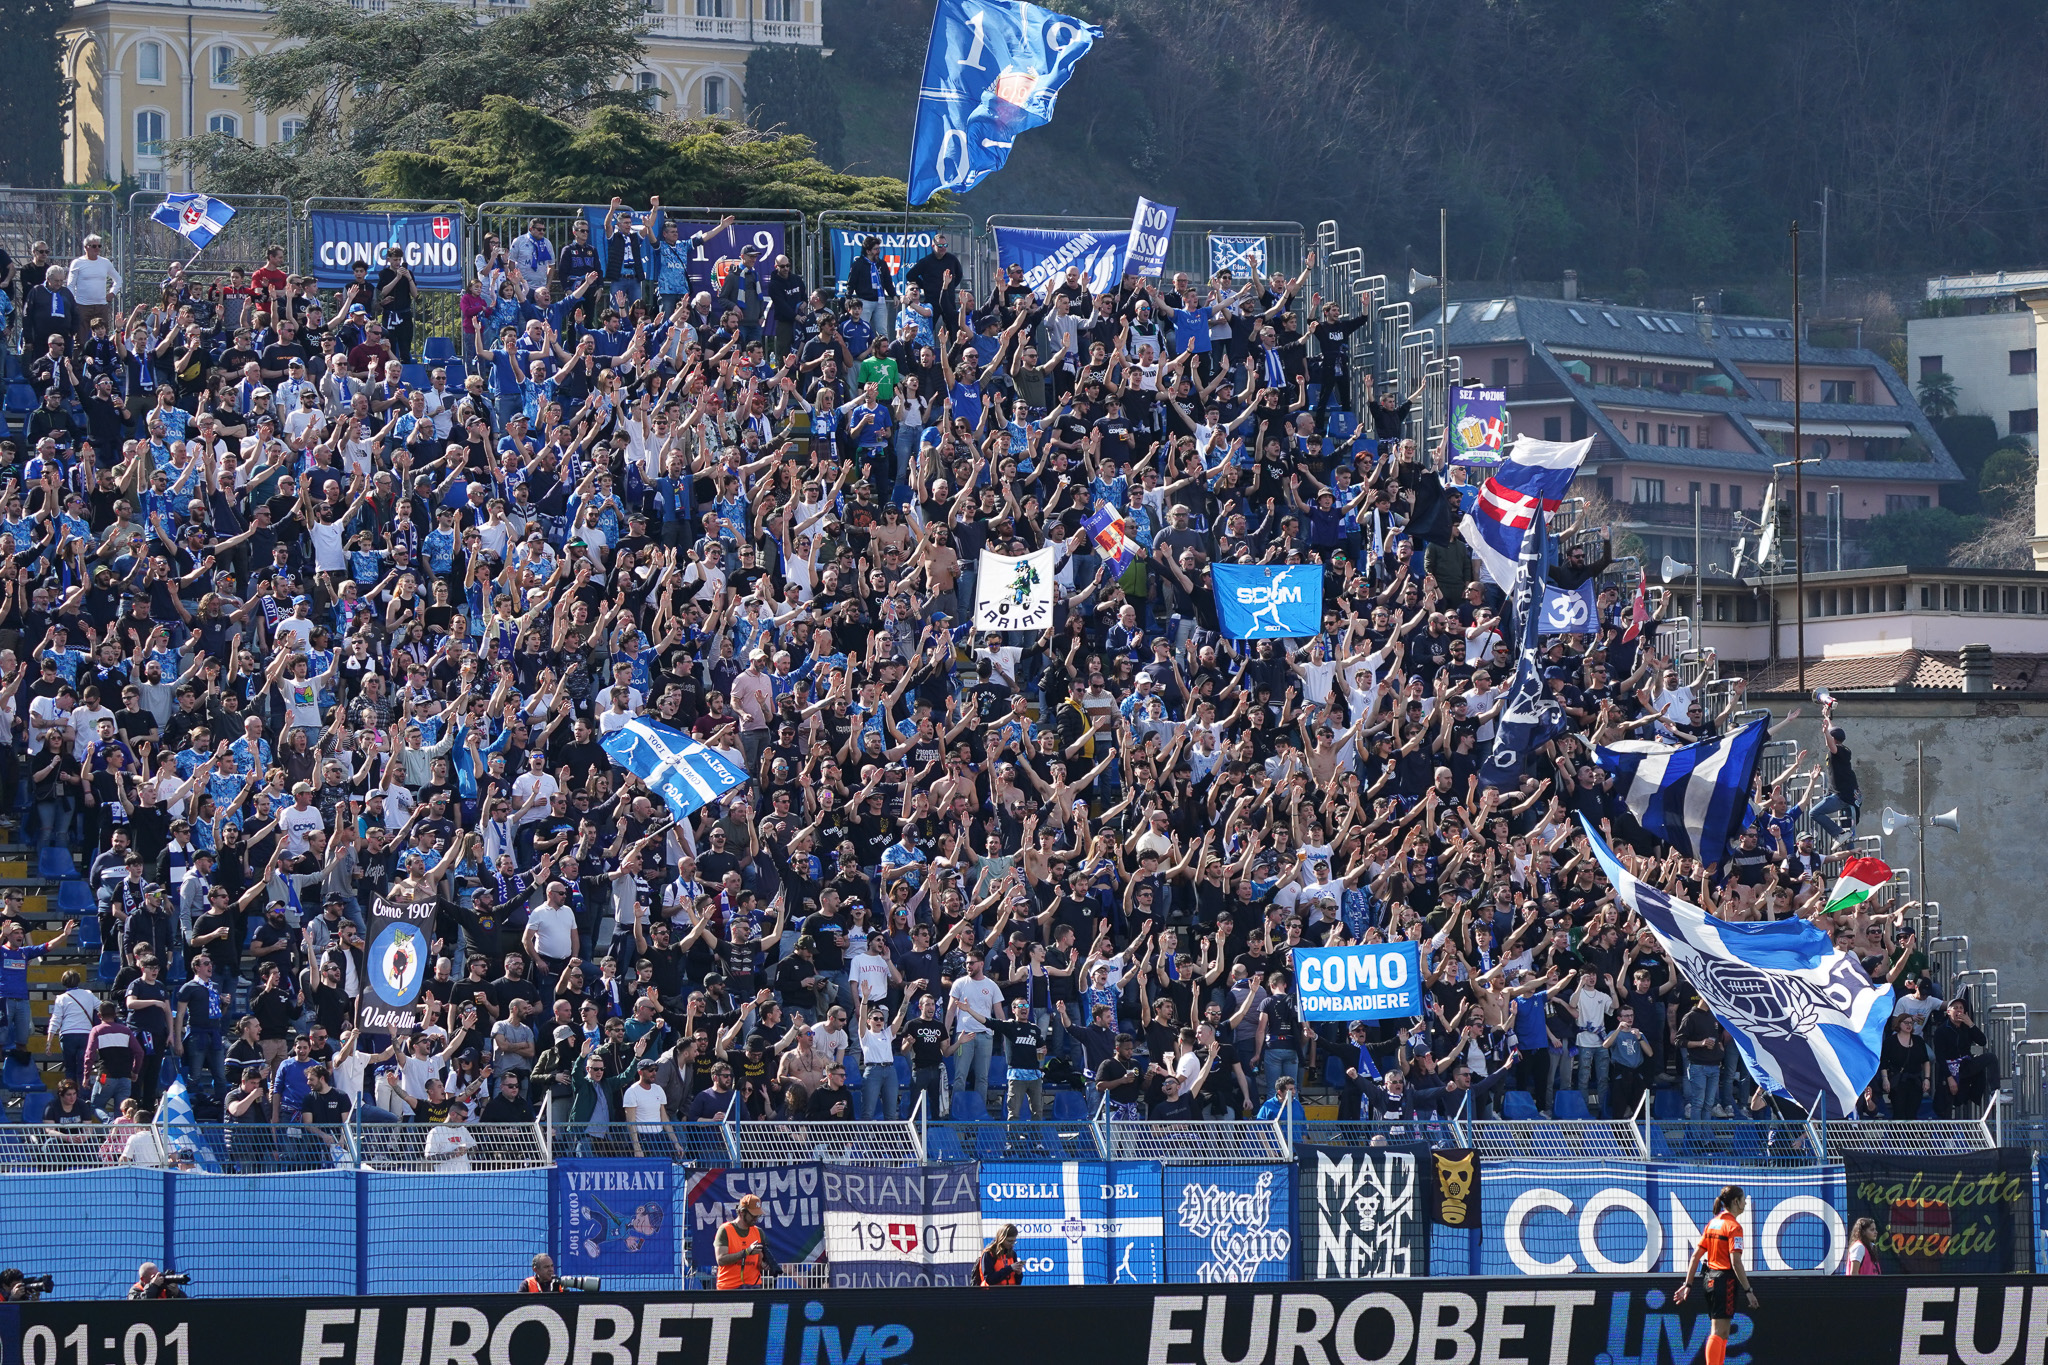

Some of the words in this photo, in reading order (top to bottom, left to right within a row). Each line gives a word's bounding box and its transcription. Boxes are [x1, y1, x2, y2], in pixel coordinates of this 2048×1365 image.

[1022, 233, 1098, 289] EDELISSIMI
[1236, 586, 1302, 605] SCUM
[978, 600, 1050, 629] LARIANI
[372, 897, 404, 920] Como
[407, 902, 437, 919] 1907
[1300, 952, 1408, 992] COMO
[361, 1006, 416, 1029] Valtellin
[916, 1027, 942, 1037] COMO
[923, 1036, 938, 1044] 1907
[566, 1171, 665, 1191] VETERANI
[726, 1166, 818, 1201] COMO
[823, 1171, 976, 1206] BRIANZA
[987, 1182, 1060, 1202] QUELLI
[1100, 1183, 1139, 1200] DEL
[1316, 1150, 1416, 1218] MAD
[1856, 1170, 2025, 1208] maledetta
[568, 1192, 579, 1226] COMO
[569, 1228, 579, 1257] 1907
[851, 1220, 886, 1252] 19
[922, 1223, 958, 1254] 07
[1016, 1223, 1053, 1233] COMO
[1094, 1223, 1123, 1233] 1907
[1503, 1187, 1847, 1276] COMO
[1876, 1214, 1996, 1257] ioventù
[1022, 1256, 1055, 1273] AGO
[22, 1321, 189, 1365] 01:01
[300, 1303, 754, 1365] EUROBET
[1147, 1290, 1596, 1365] EUROBET
